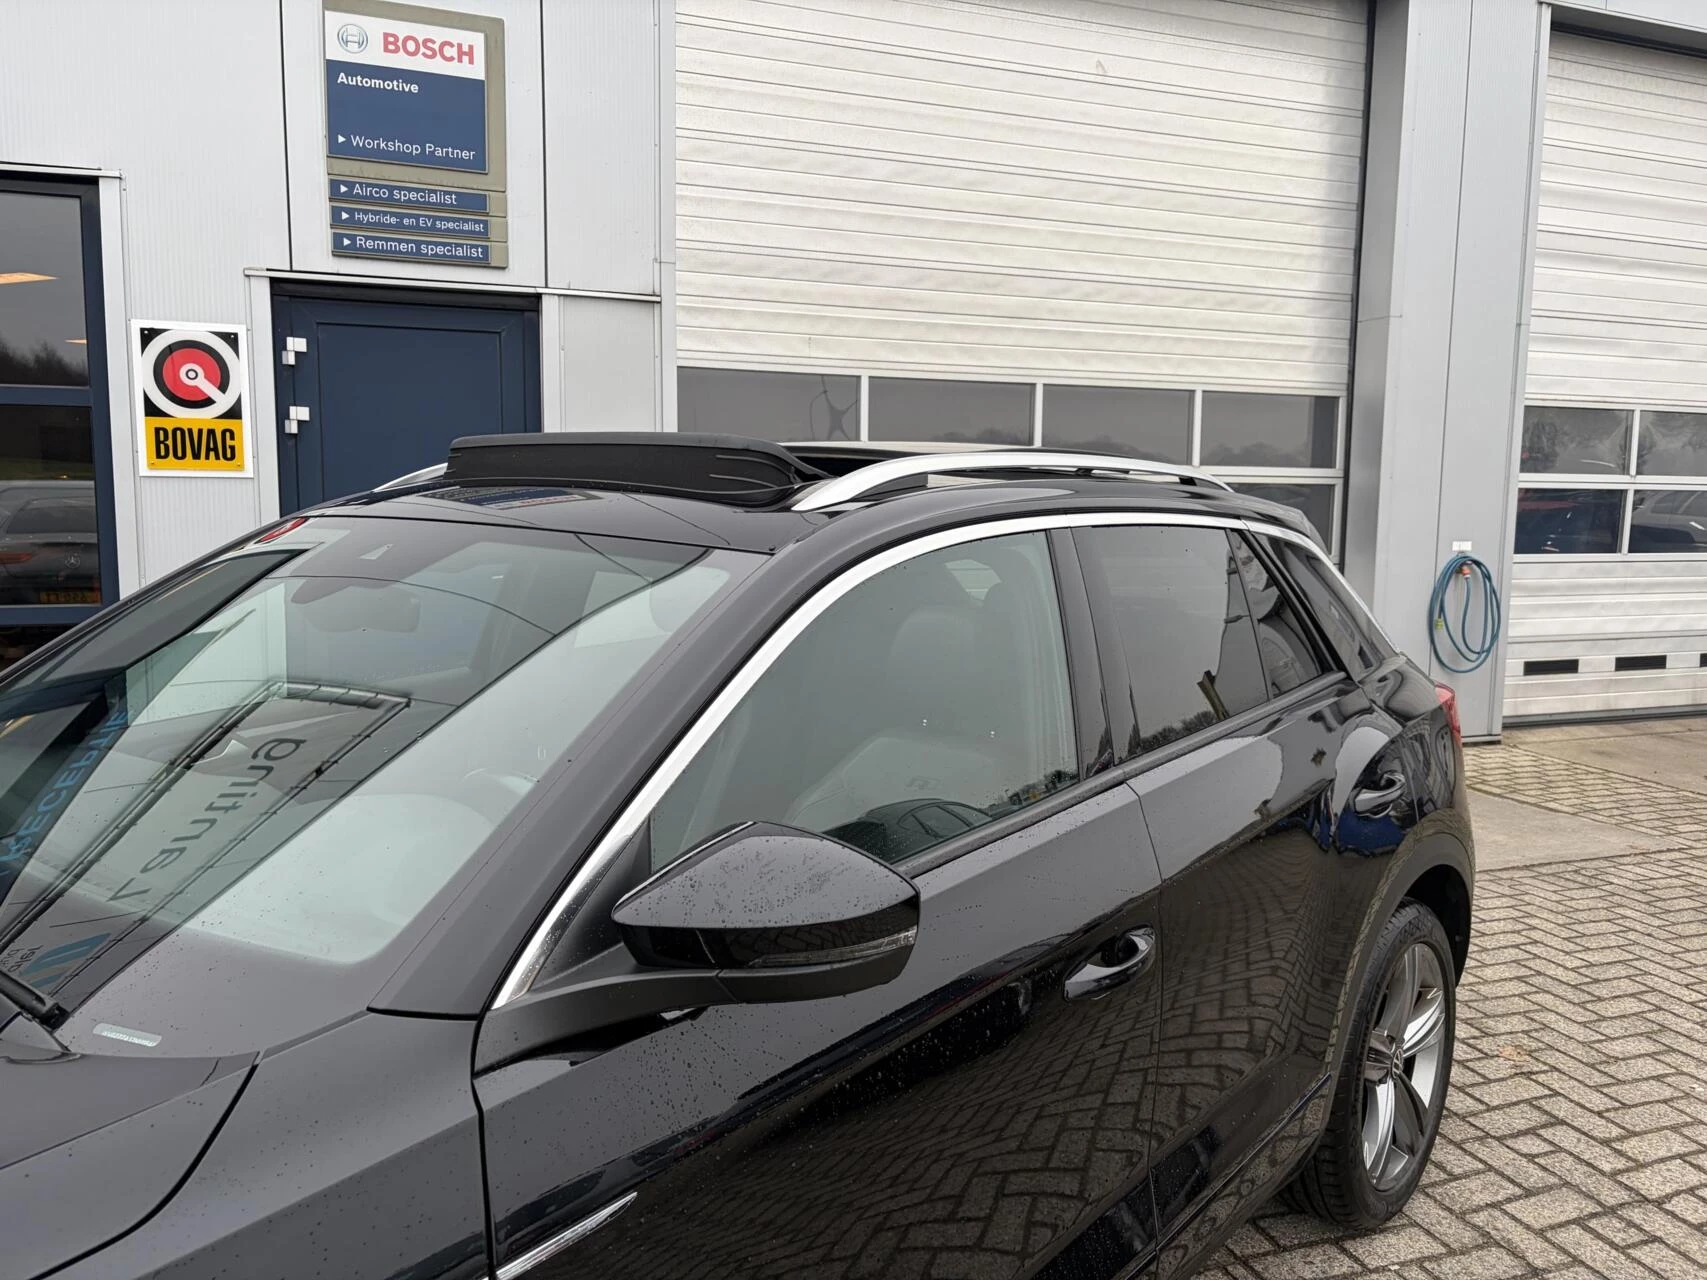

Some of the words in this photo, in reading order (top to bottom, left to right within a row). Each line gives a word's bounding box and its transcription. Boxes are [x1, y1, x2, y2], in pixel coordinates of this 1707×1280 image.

[382, 32, 474, 65] BOSCH
[337, 73, 419, 93] Automotive
[351, 135, 421, 154] Workshop
[426, 144, 475, 160] Partner
[353, 184, 388, 198] Airco
[393, 189, 457, 205] specialist
[355, 212, 400, 225] Hybride-
[403, 217, 416, 227] en
[420, 218, 432, 227] EV
[436, 219, 484, 231] specialist
[356, 237, 415, 252] Remmen
[421, 243, 482, 257] specialist
[154, 428, 236, 461] BOVAG
